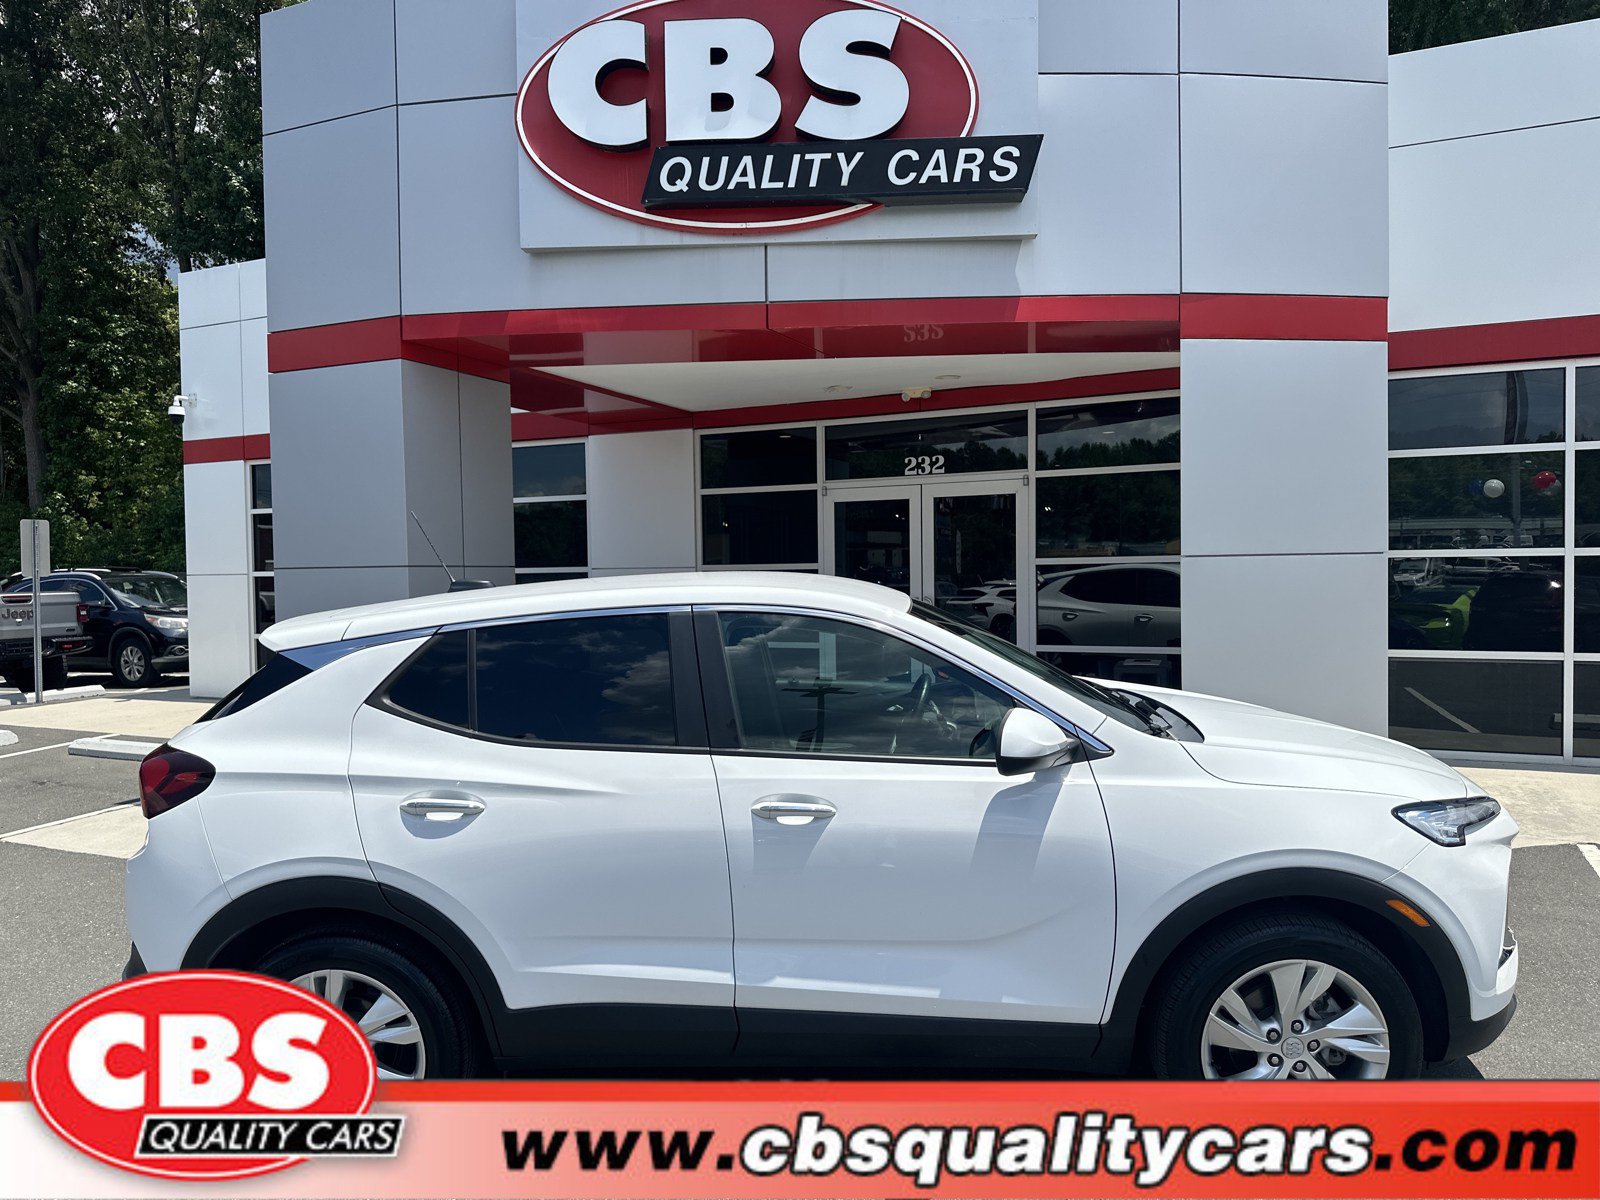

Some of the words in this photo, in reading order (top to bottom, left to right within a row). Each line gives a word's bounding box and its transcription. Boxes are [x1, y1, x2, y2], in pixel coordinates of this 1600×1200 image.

[548, 9, 910, 149] CBS
[659, 151, 864, 193] QUALITY
[886, 145, 1021, 186] CARS
[904, 455, 945, 475] 232
